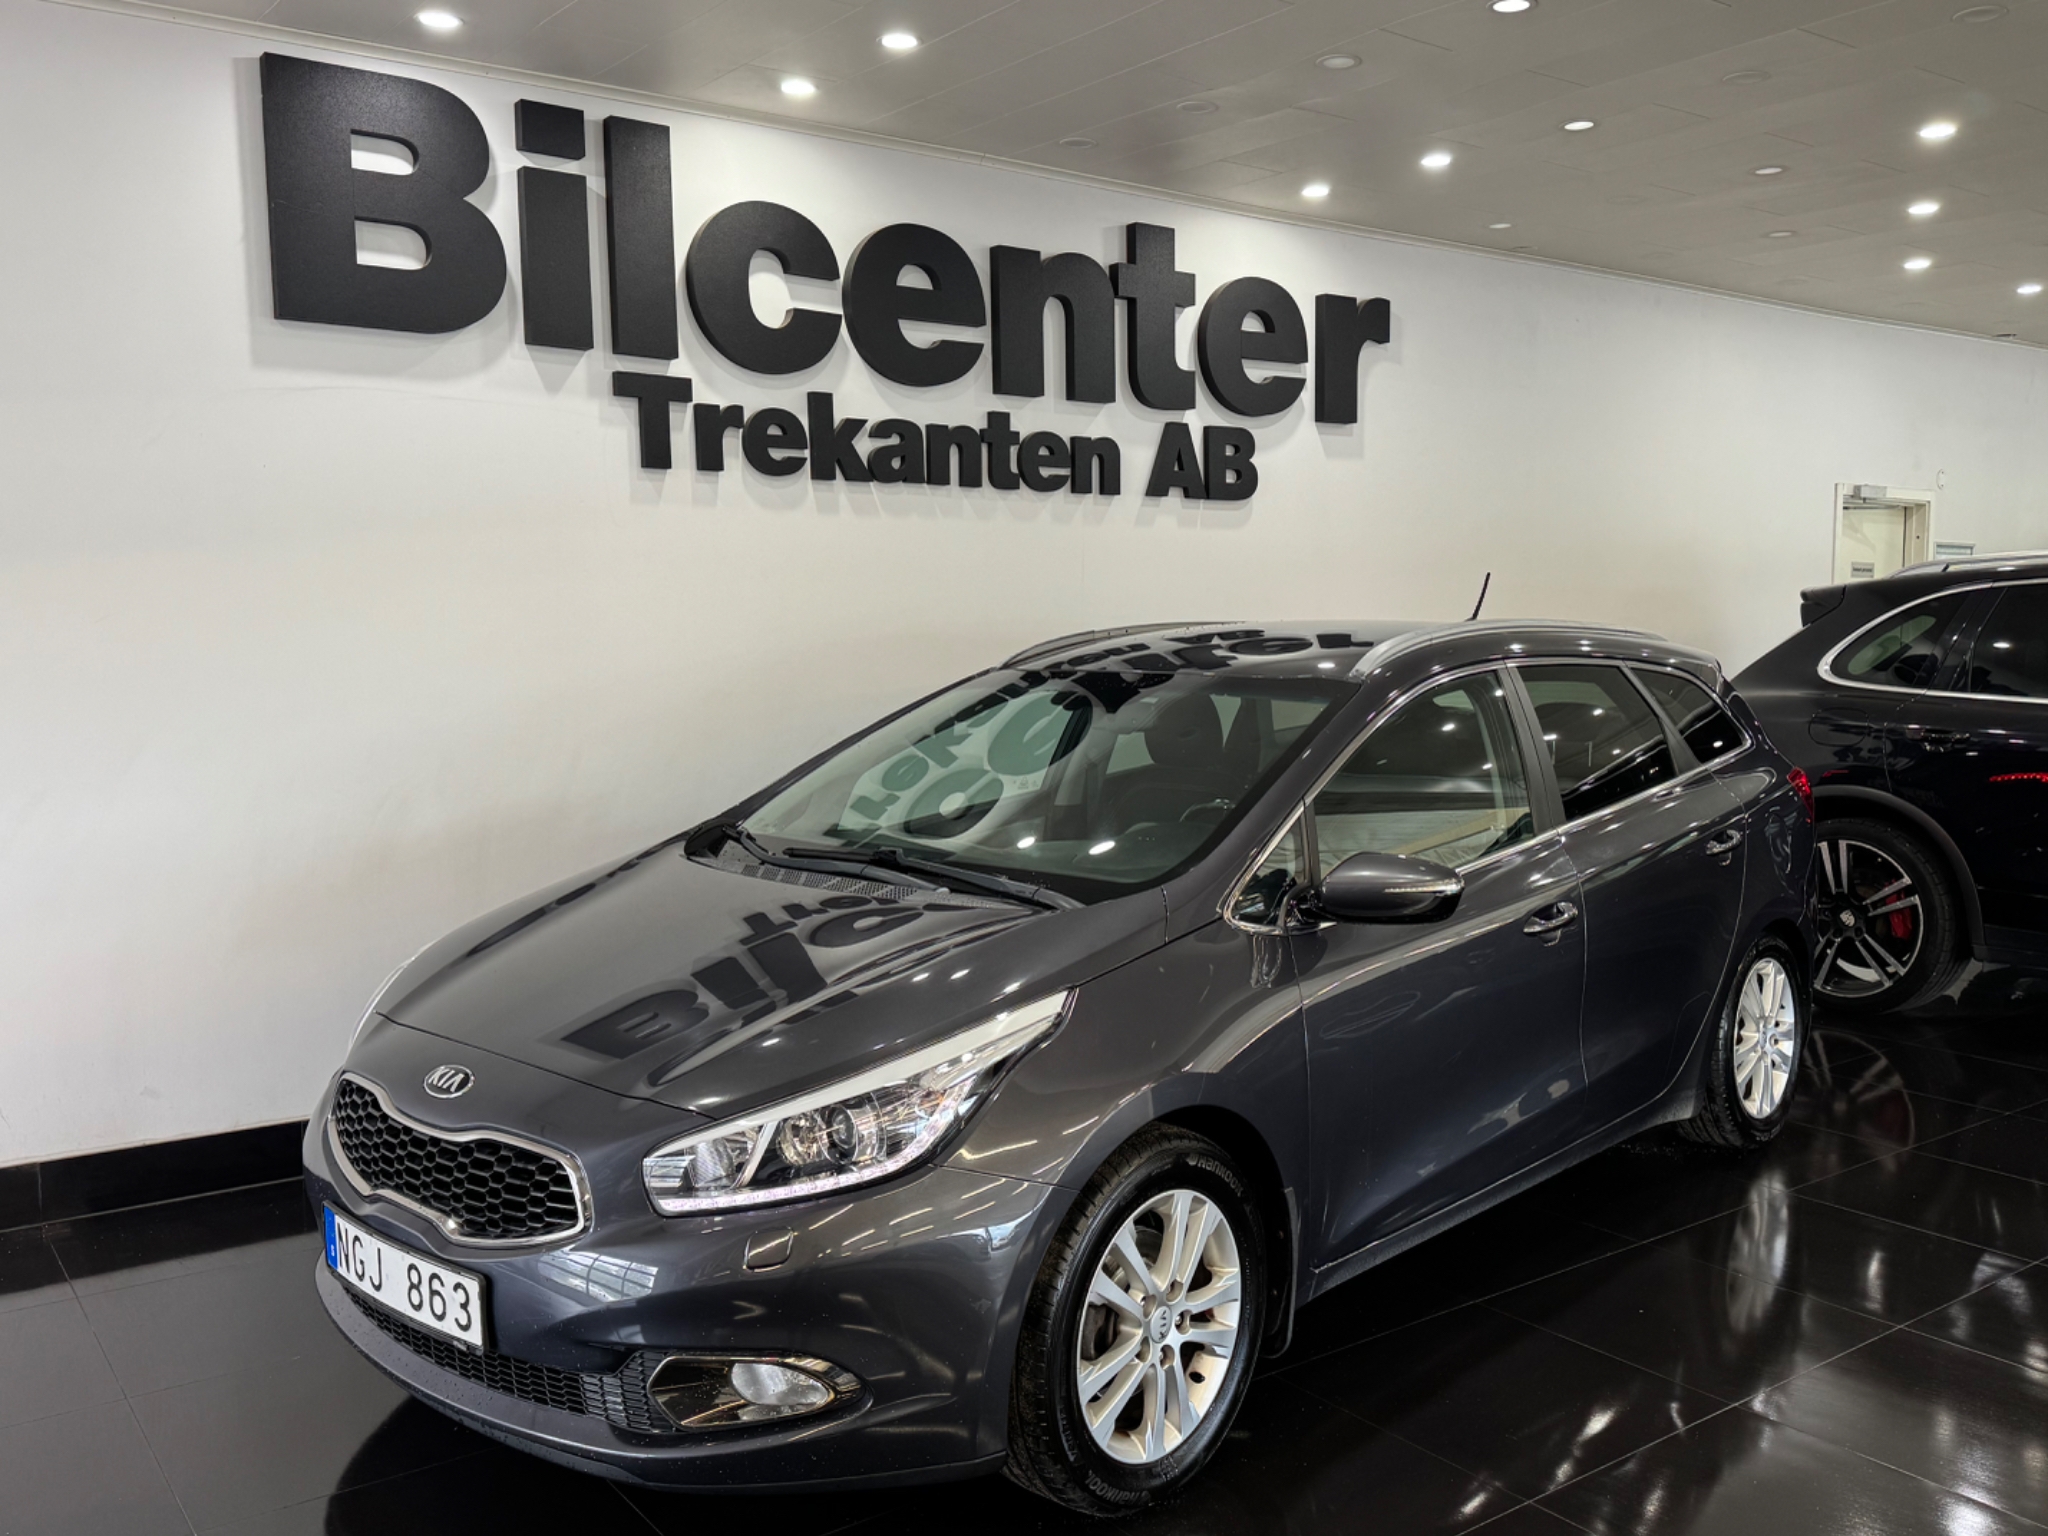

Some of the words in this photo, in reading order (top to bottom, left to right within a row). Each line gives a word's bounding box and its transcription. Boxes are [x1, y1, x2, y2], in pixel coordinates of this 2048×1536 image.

[260, 52, 1390, 425] Bilcenter
[612, 370, 1121, 496] Trekanten
[1145, 421, 1259, 501] AB
[428, 1067, 466, 1093] KIA
[336, 1221, 383, 1293] NGJ
[406, 1262, 473, 1333] 863
